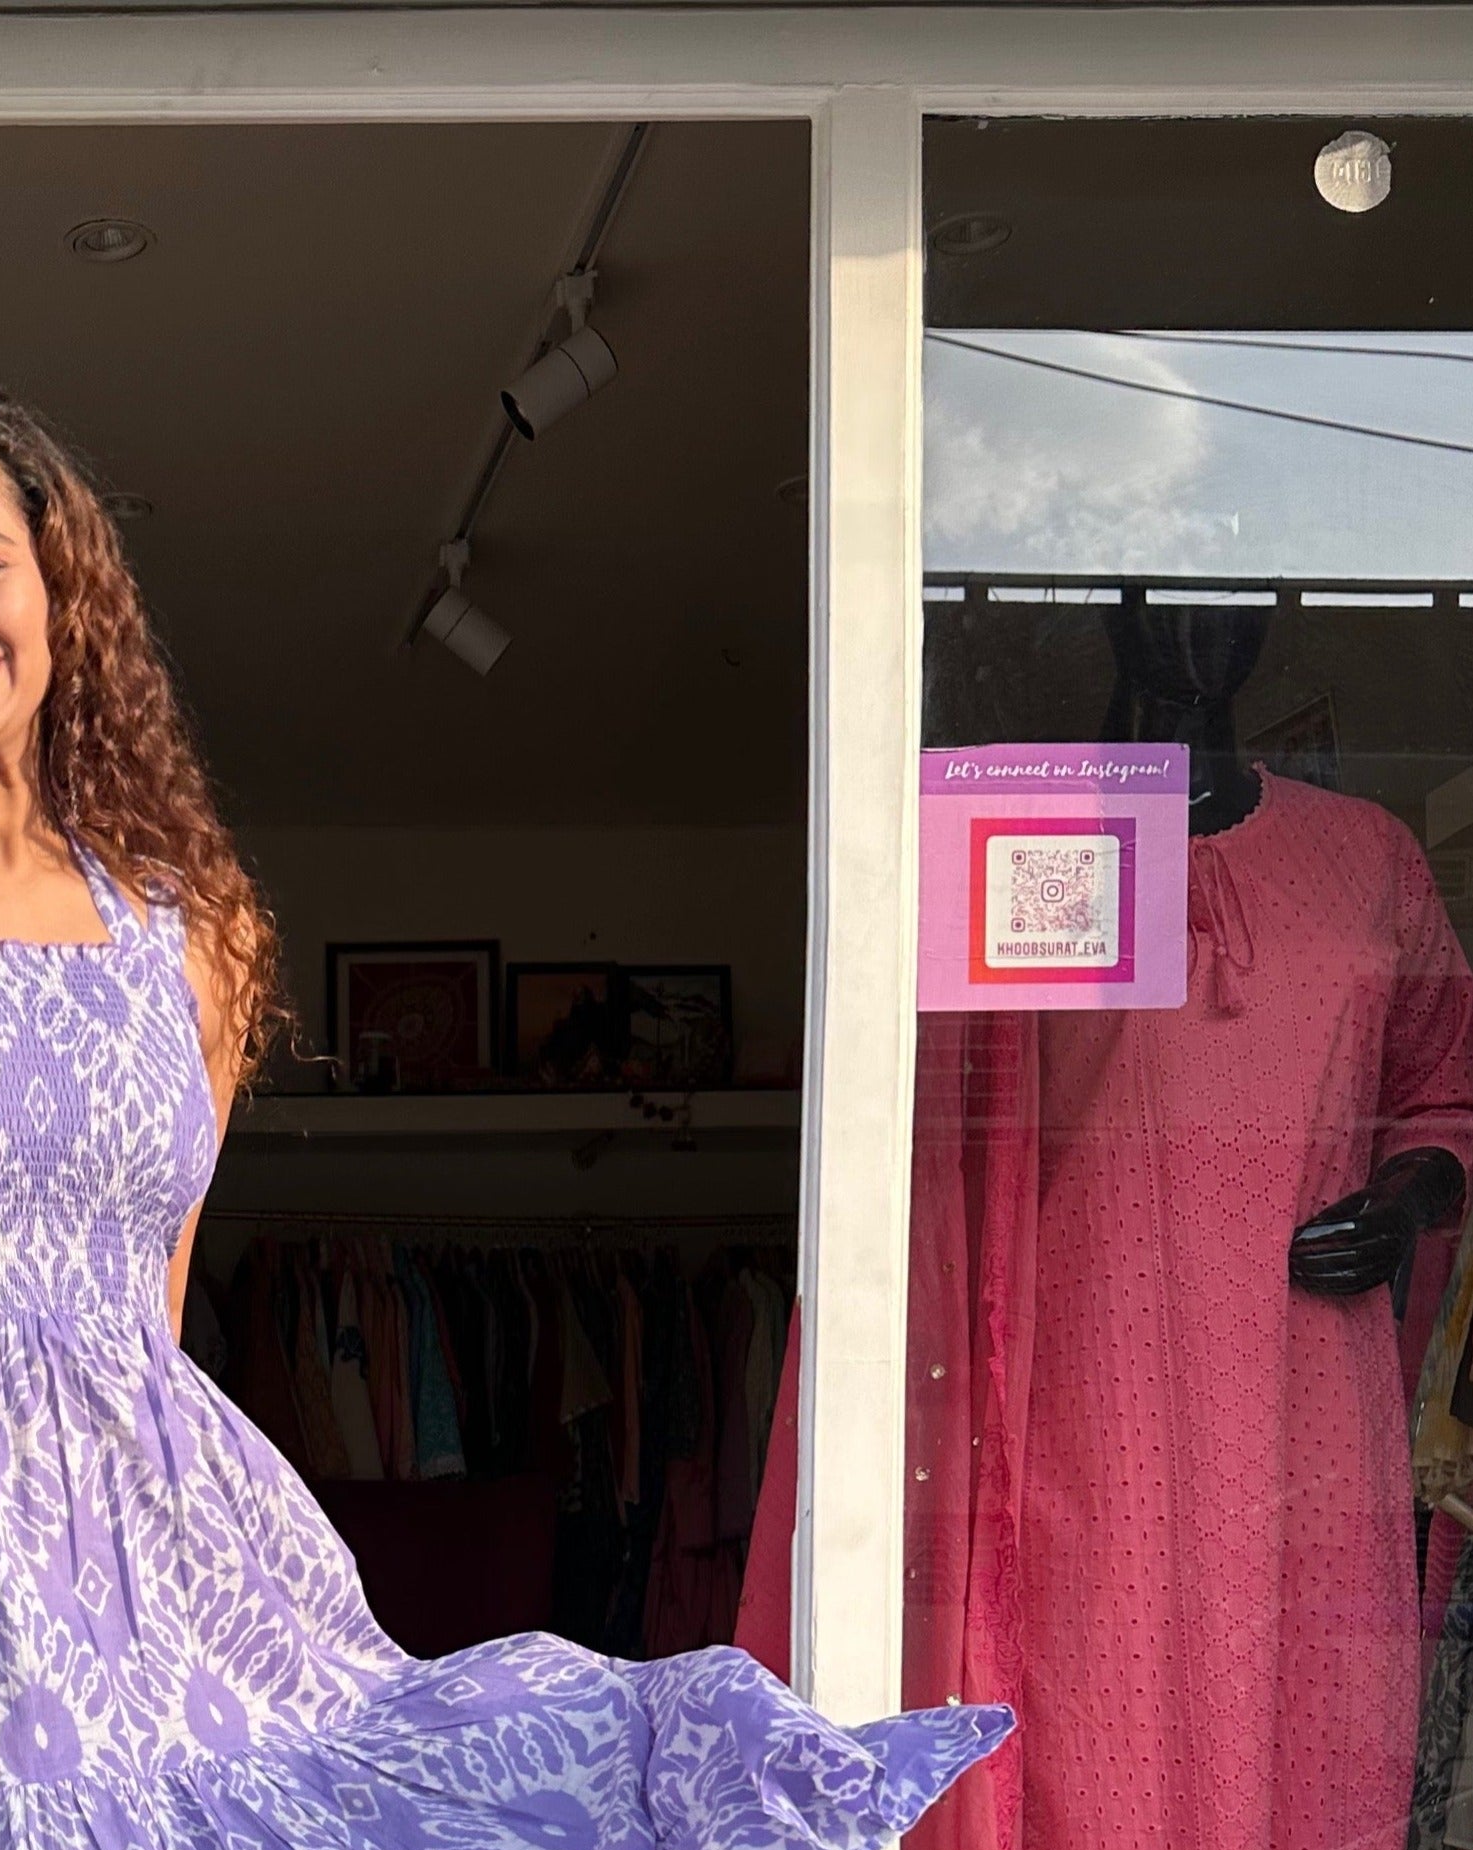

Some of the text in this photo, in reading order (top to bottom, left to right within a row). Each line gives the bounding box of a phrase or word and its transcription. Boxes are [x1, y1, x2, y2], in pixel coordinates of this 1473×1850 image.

[945, 760, 1170, 784] Let's connect on Instagram!
[997, 941, 1107, 956] KHOOBSURAT_EVA
